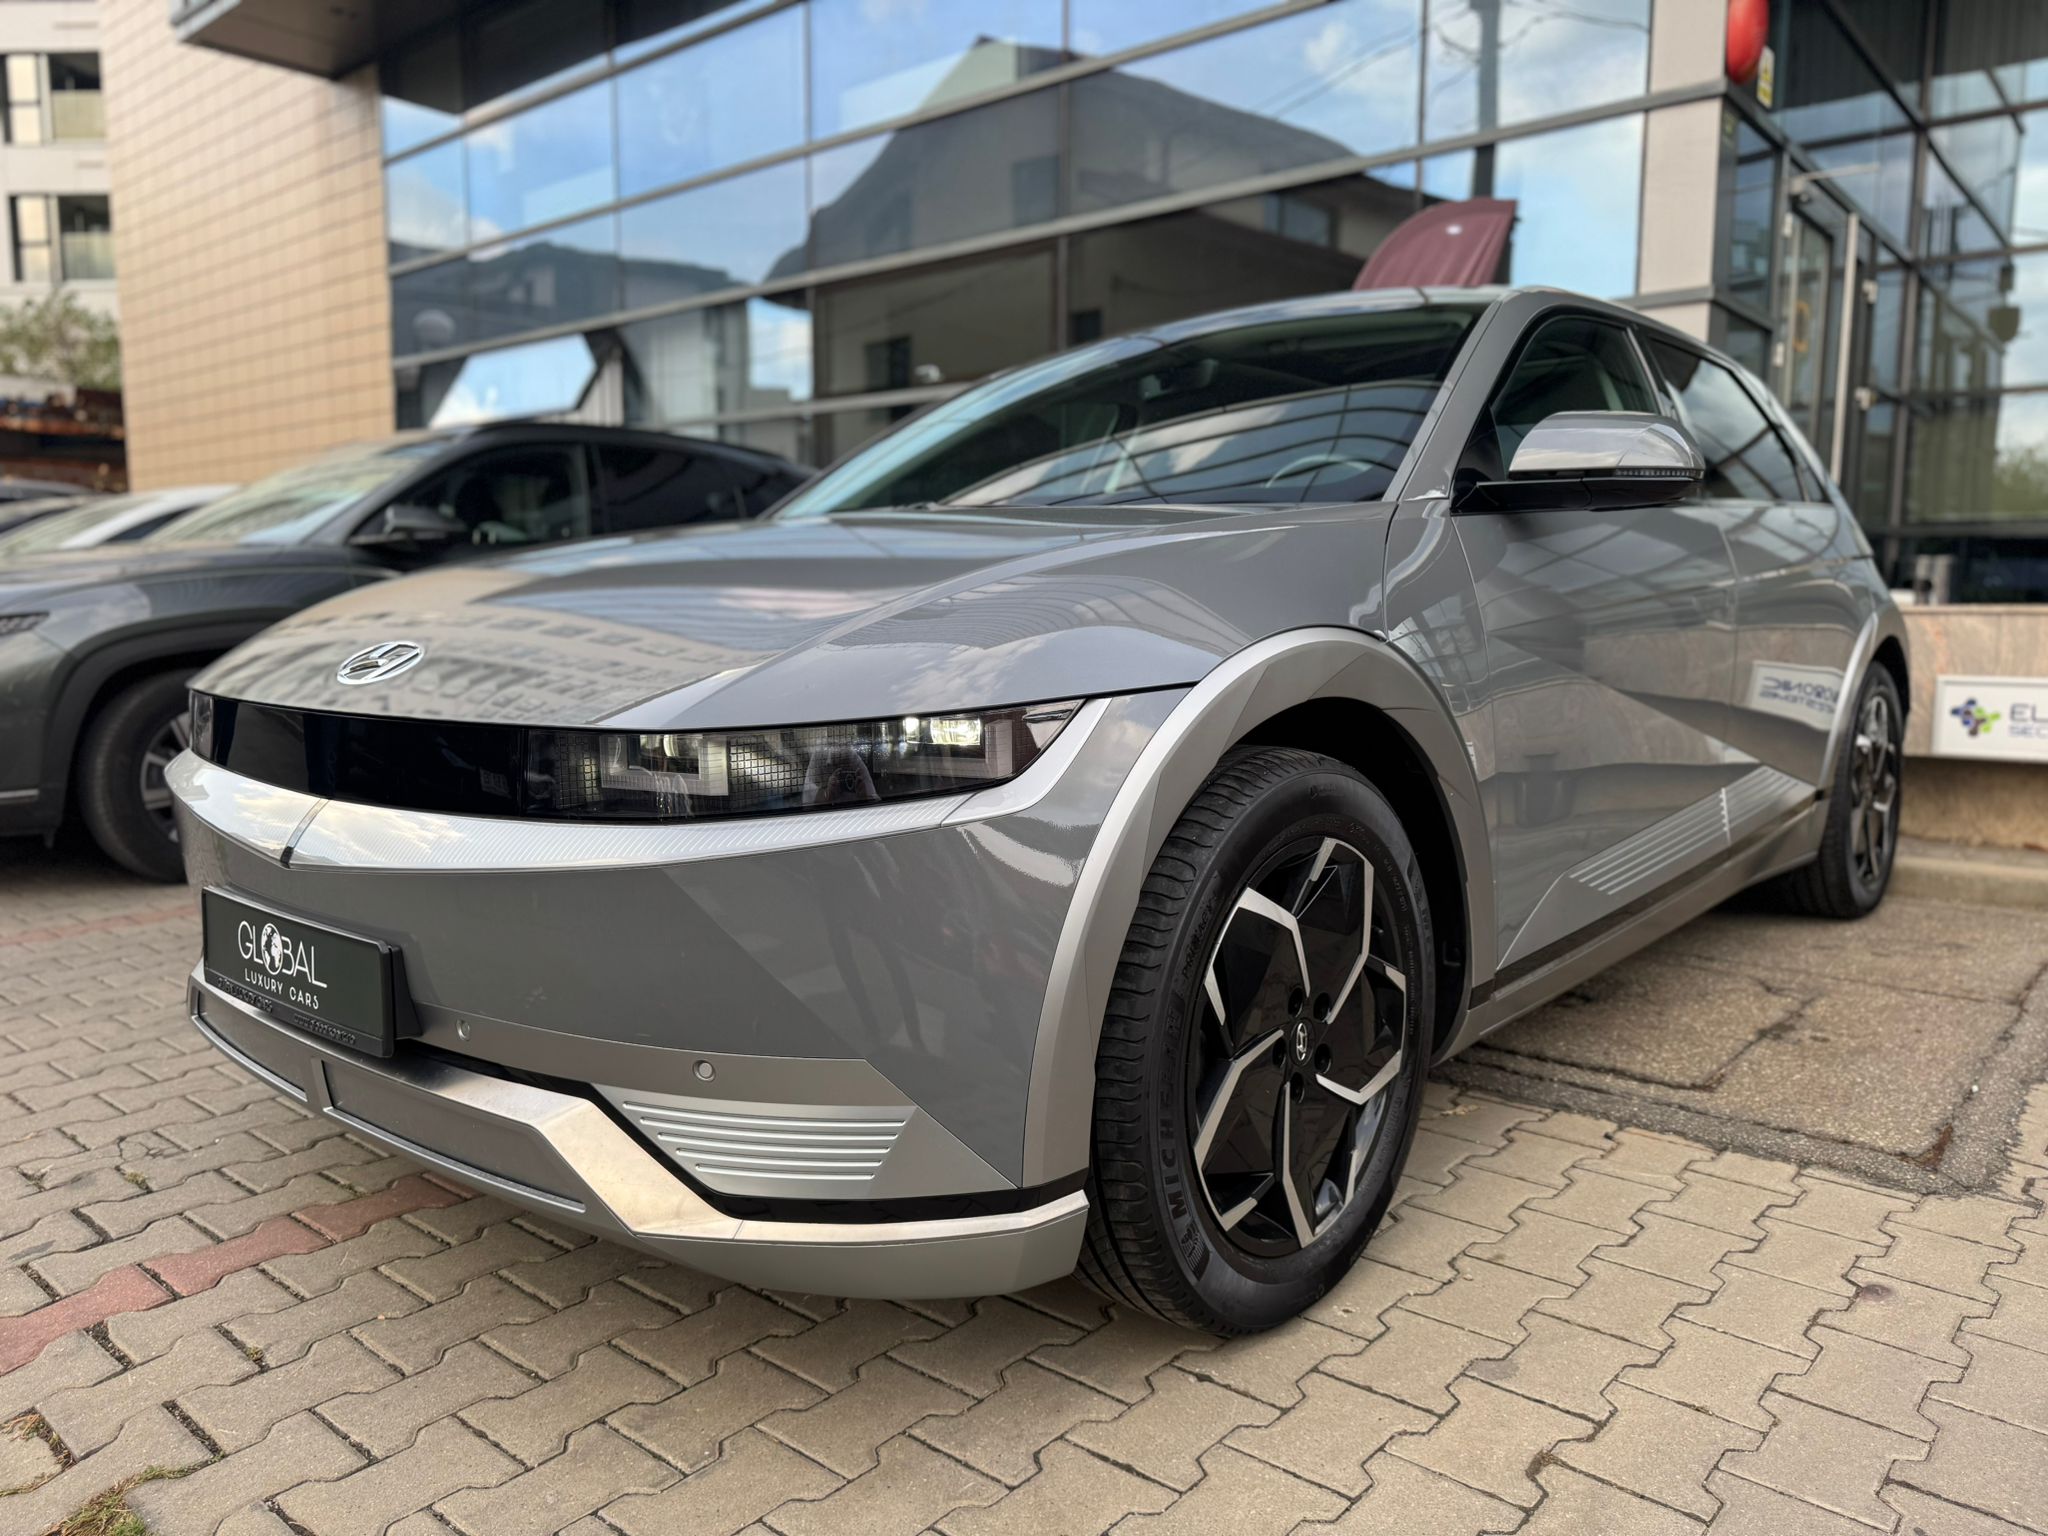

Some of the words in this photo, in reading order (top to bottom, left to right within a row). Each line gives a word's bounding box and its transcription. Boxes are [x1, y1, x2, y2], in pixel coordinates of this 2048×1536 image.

[238, 920, 327, 988] GLOBAL
[244, 968, 283, 995] LUXURY
[289, 986, 319, 1009] CARS
